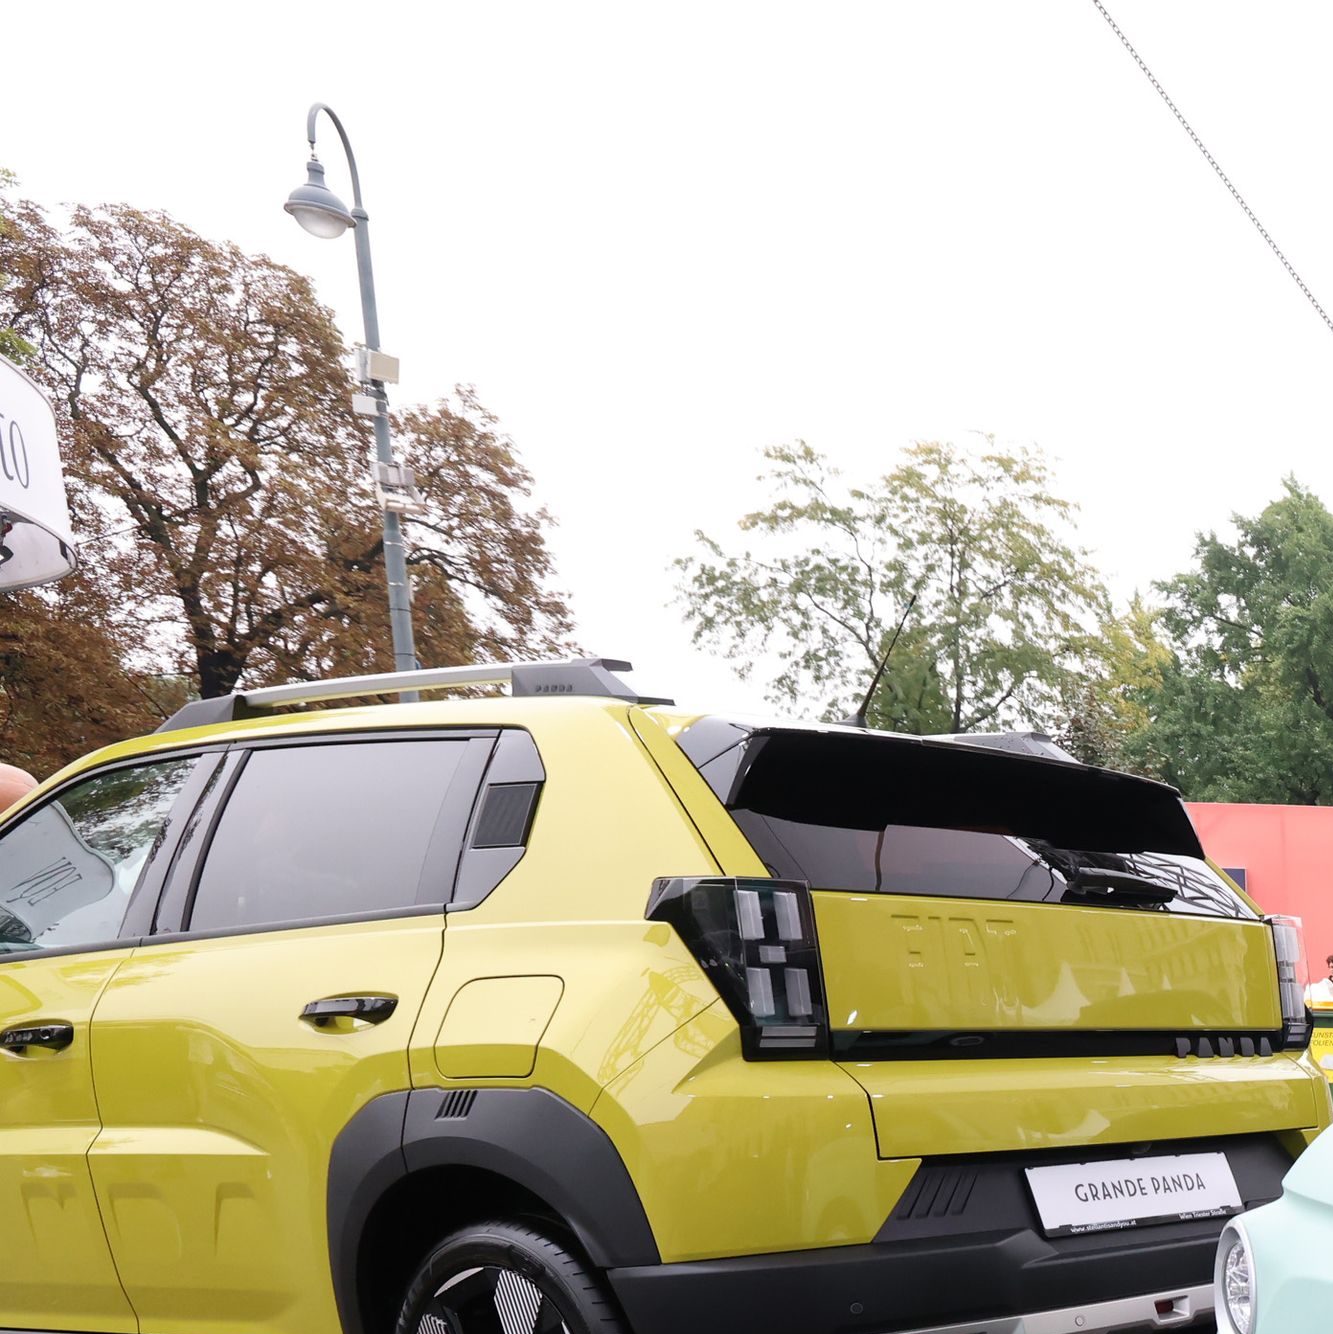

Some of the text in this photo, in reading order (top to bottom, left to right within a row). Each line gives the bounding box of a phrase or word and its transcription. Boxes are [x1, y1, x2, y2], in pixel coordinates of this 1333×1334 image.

[1175, 1036, 1273, 1058] PANDA
[1074, 1172, 1207, 1203] GRANDE PANDA
[1179, 1211, 1193, 1220] Wien
